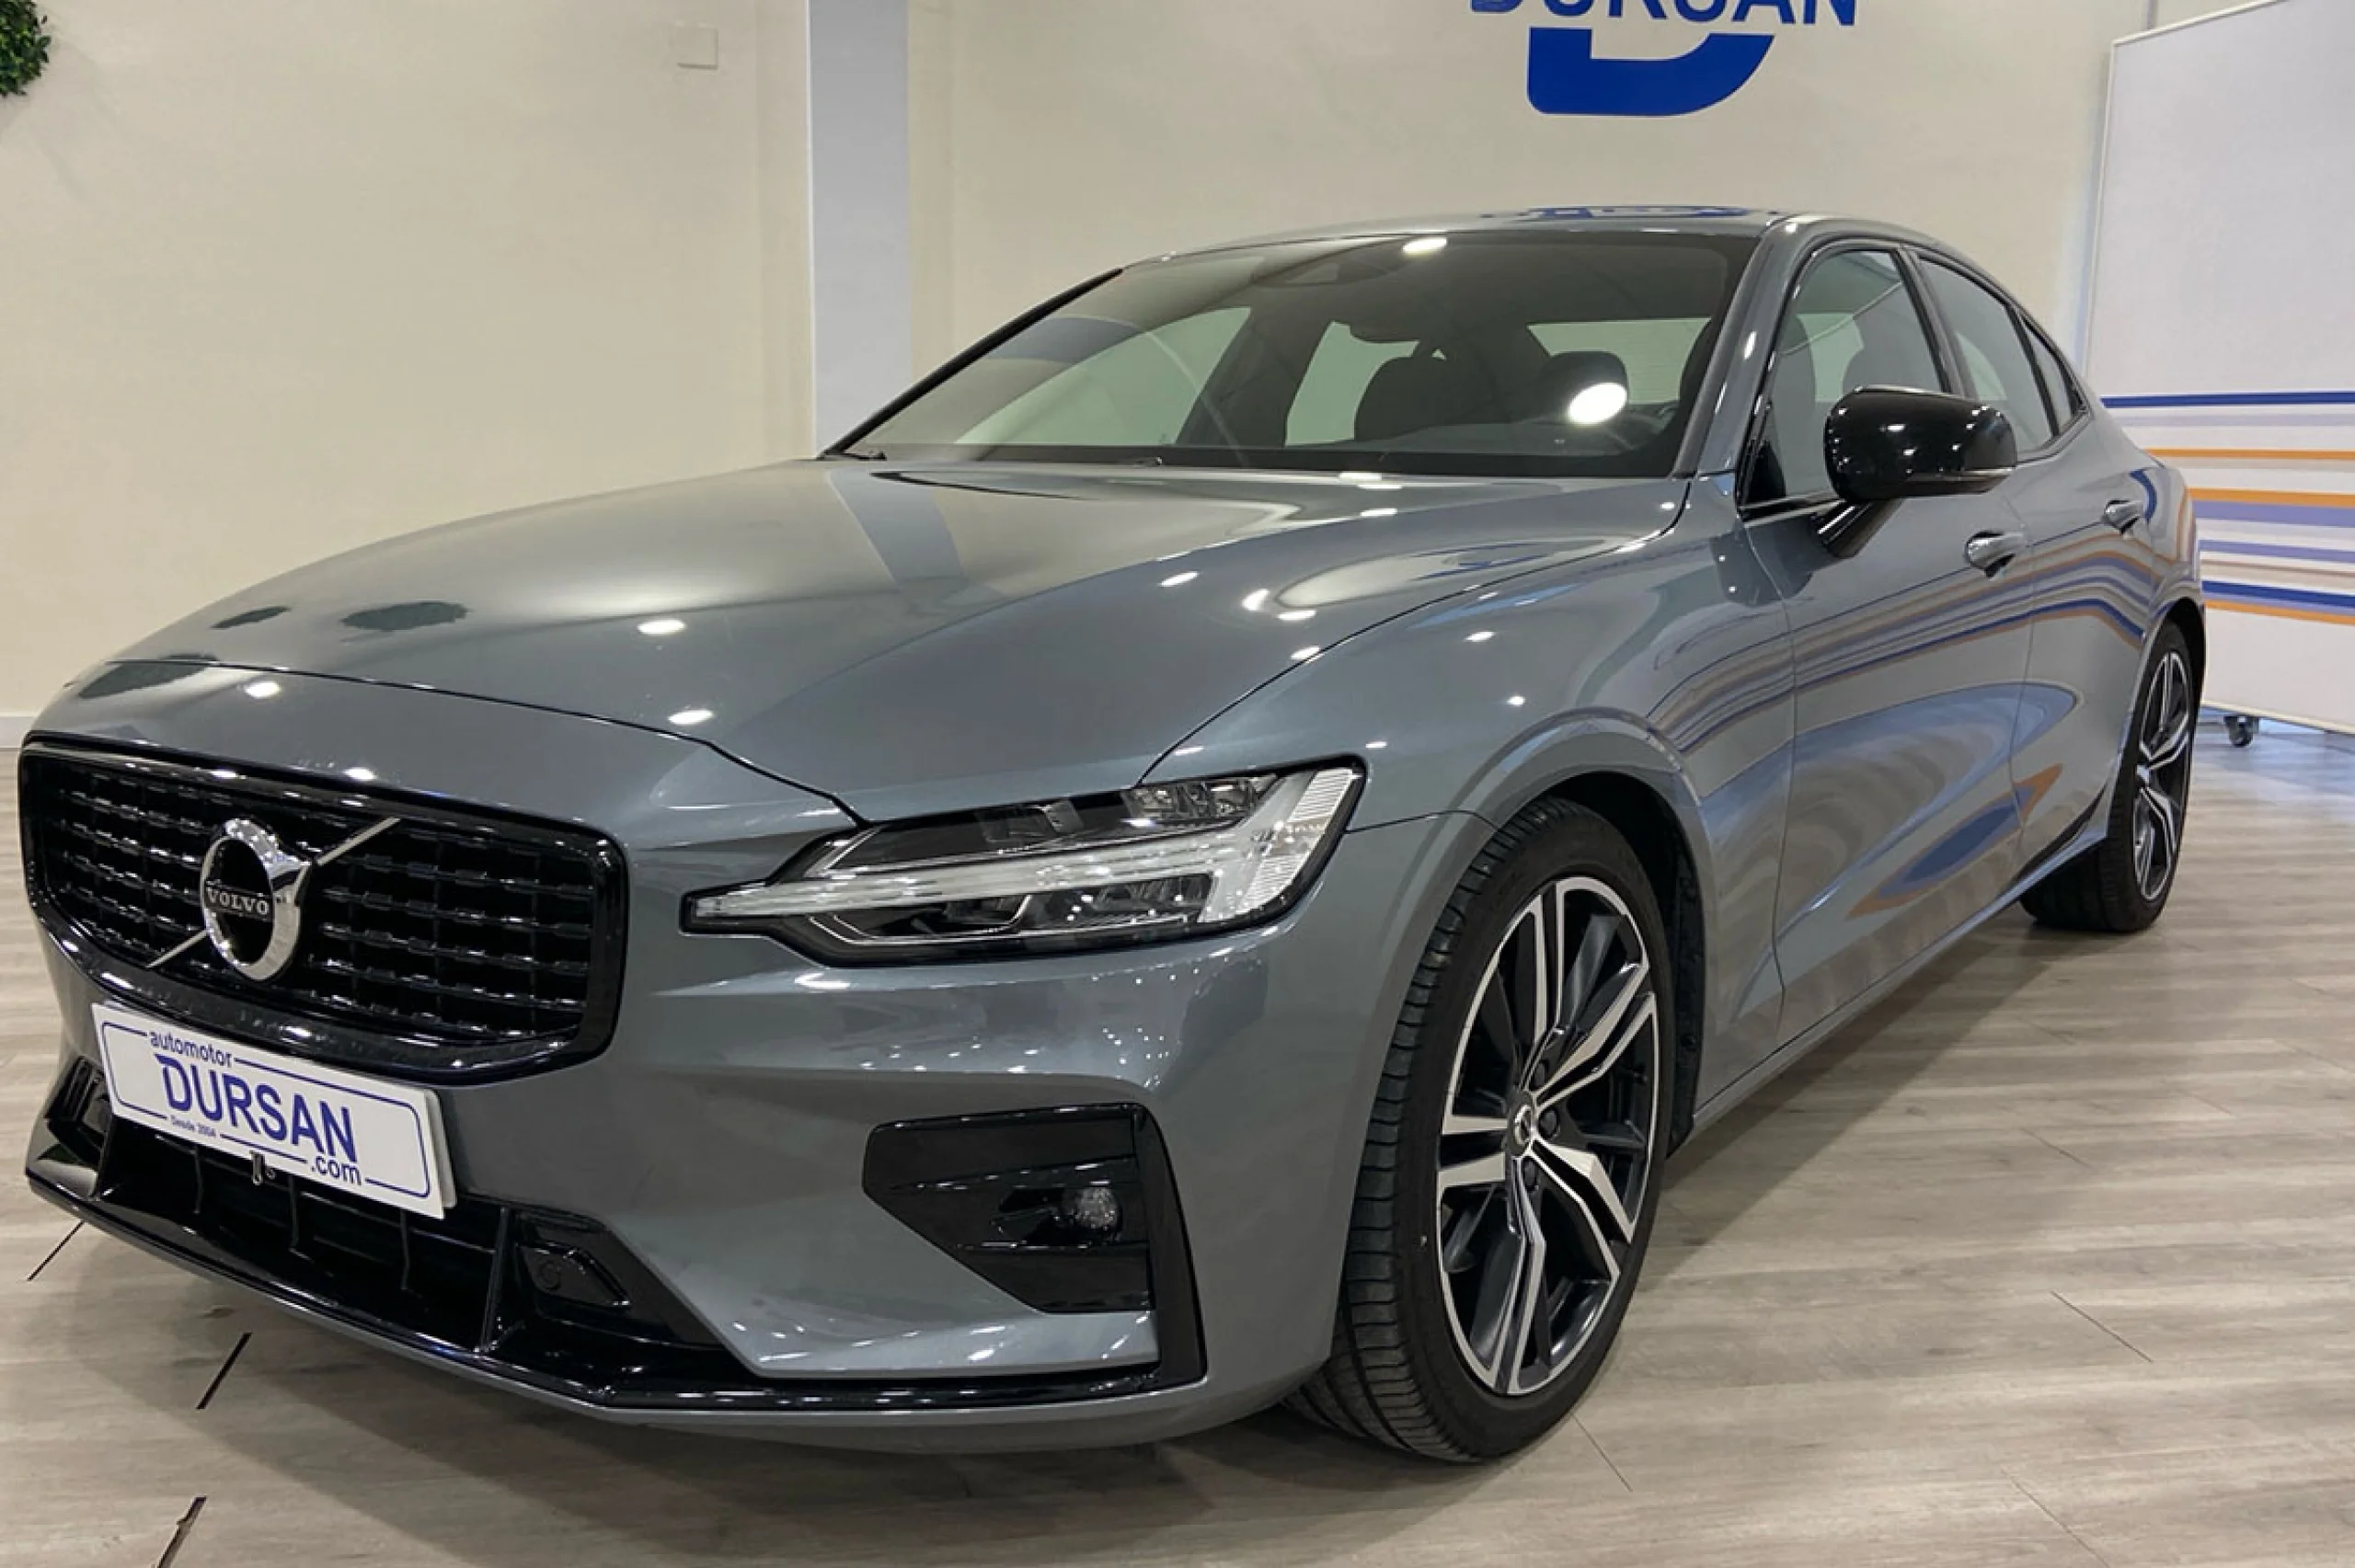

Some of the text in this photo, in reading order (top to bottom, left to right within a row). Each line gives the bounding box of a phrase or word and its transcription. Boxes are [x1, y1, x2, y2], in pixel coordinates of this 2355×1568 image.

[206, 887, 270, 916] VOLVO
[150, 1031, 232, 1068] automotor
[155, 1053, 357, 1162] DURSAN
[310, 1155, 362, 1185] .com
